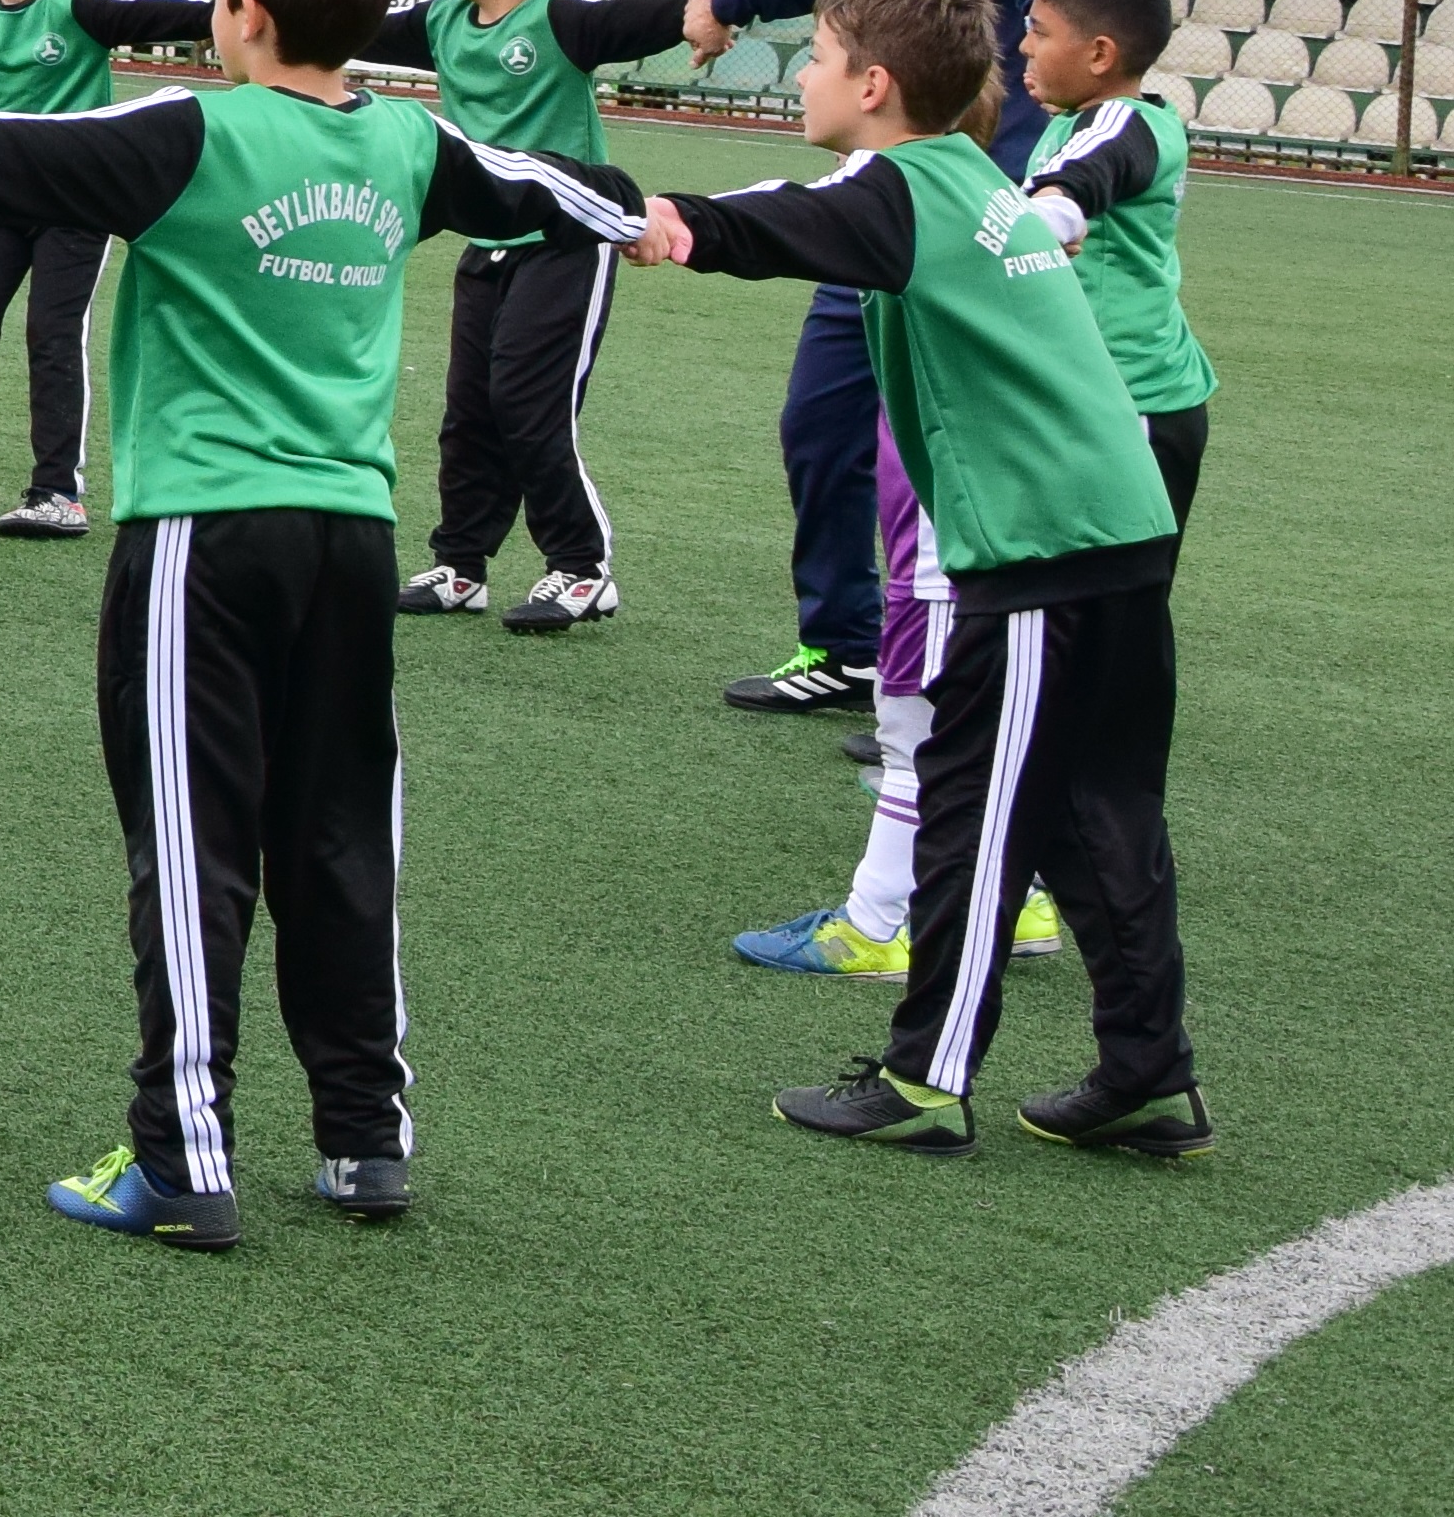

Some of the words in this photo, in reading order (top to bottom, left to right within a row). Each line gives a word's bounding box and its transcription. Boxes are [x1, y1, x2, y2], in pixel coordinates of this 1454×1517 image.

[241, 178, 379, 249] BEYLİKBAĞI
[373, 199, 405, 261] SPOR
[258, 254, 335, 284] FUTBOL
[340, 264, 387, 286] OKULU
[1003, 250, 1058, 278] FUTBOL
